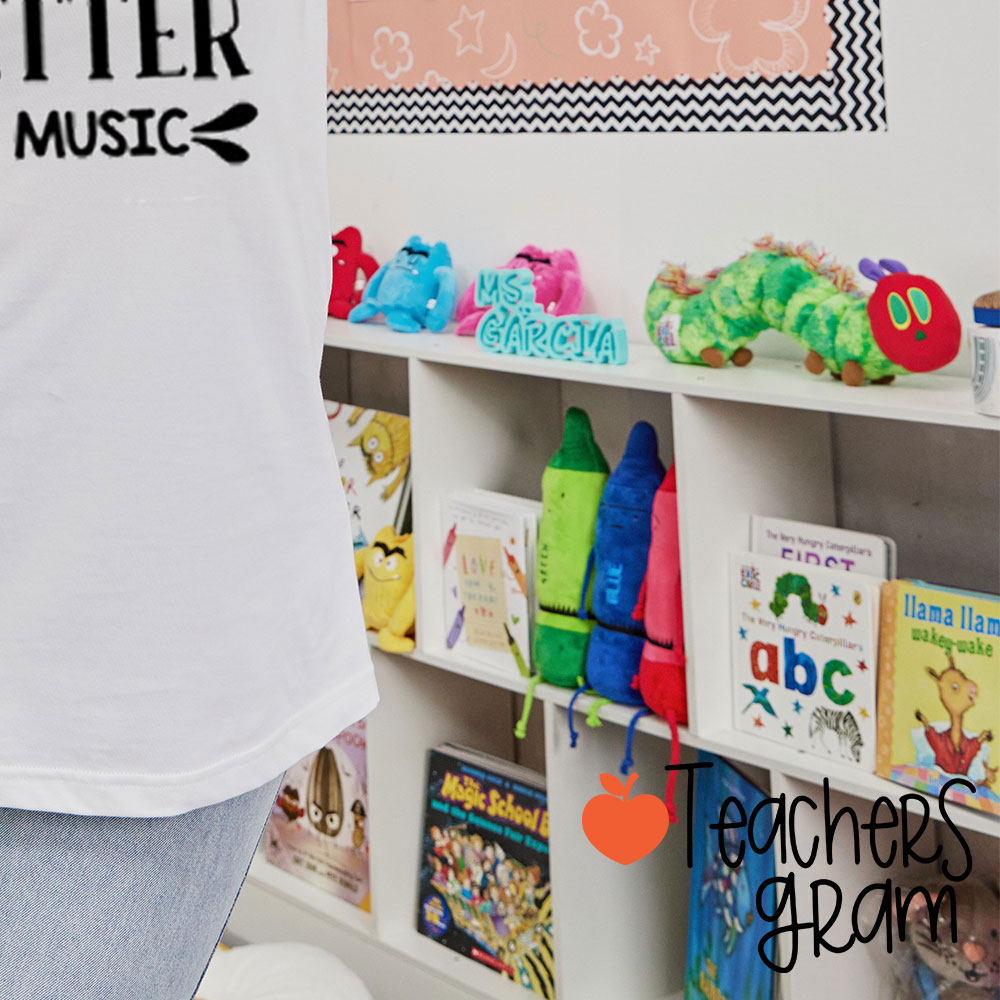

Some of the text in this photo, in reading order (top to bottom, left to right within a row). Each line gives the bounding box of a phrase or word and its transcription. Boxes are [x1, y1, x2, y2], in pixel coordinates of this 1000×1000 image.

[15, 108, 190, 159] MUSIC
[477, 311, 628, 366] GARCIA
[904, 593, 954, 628] llama
[750, 636, 855, 706] abc
[441, 771, 487, 811] Magic
[486, 788, 540, 832] School
